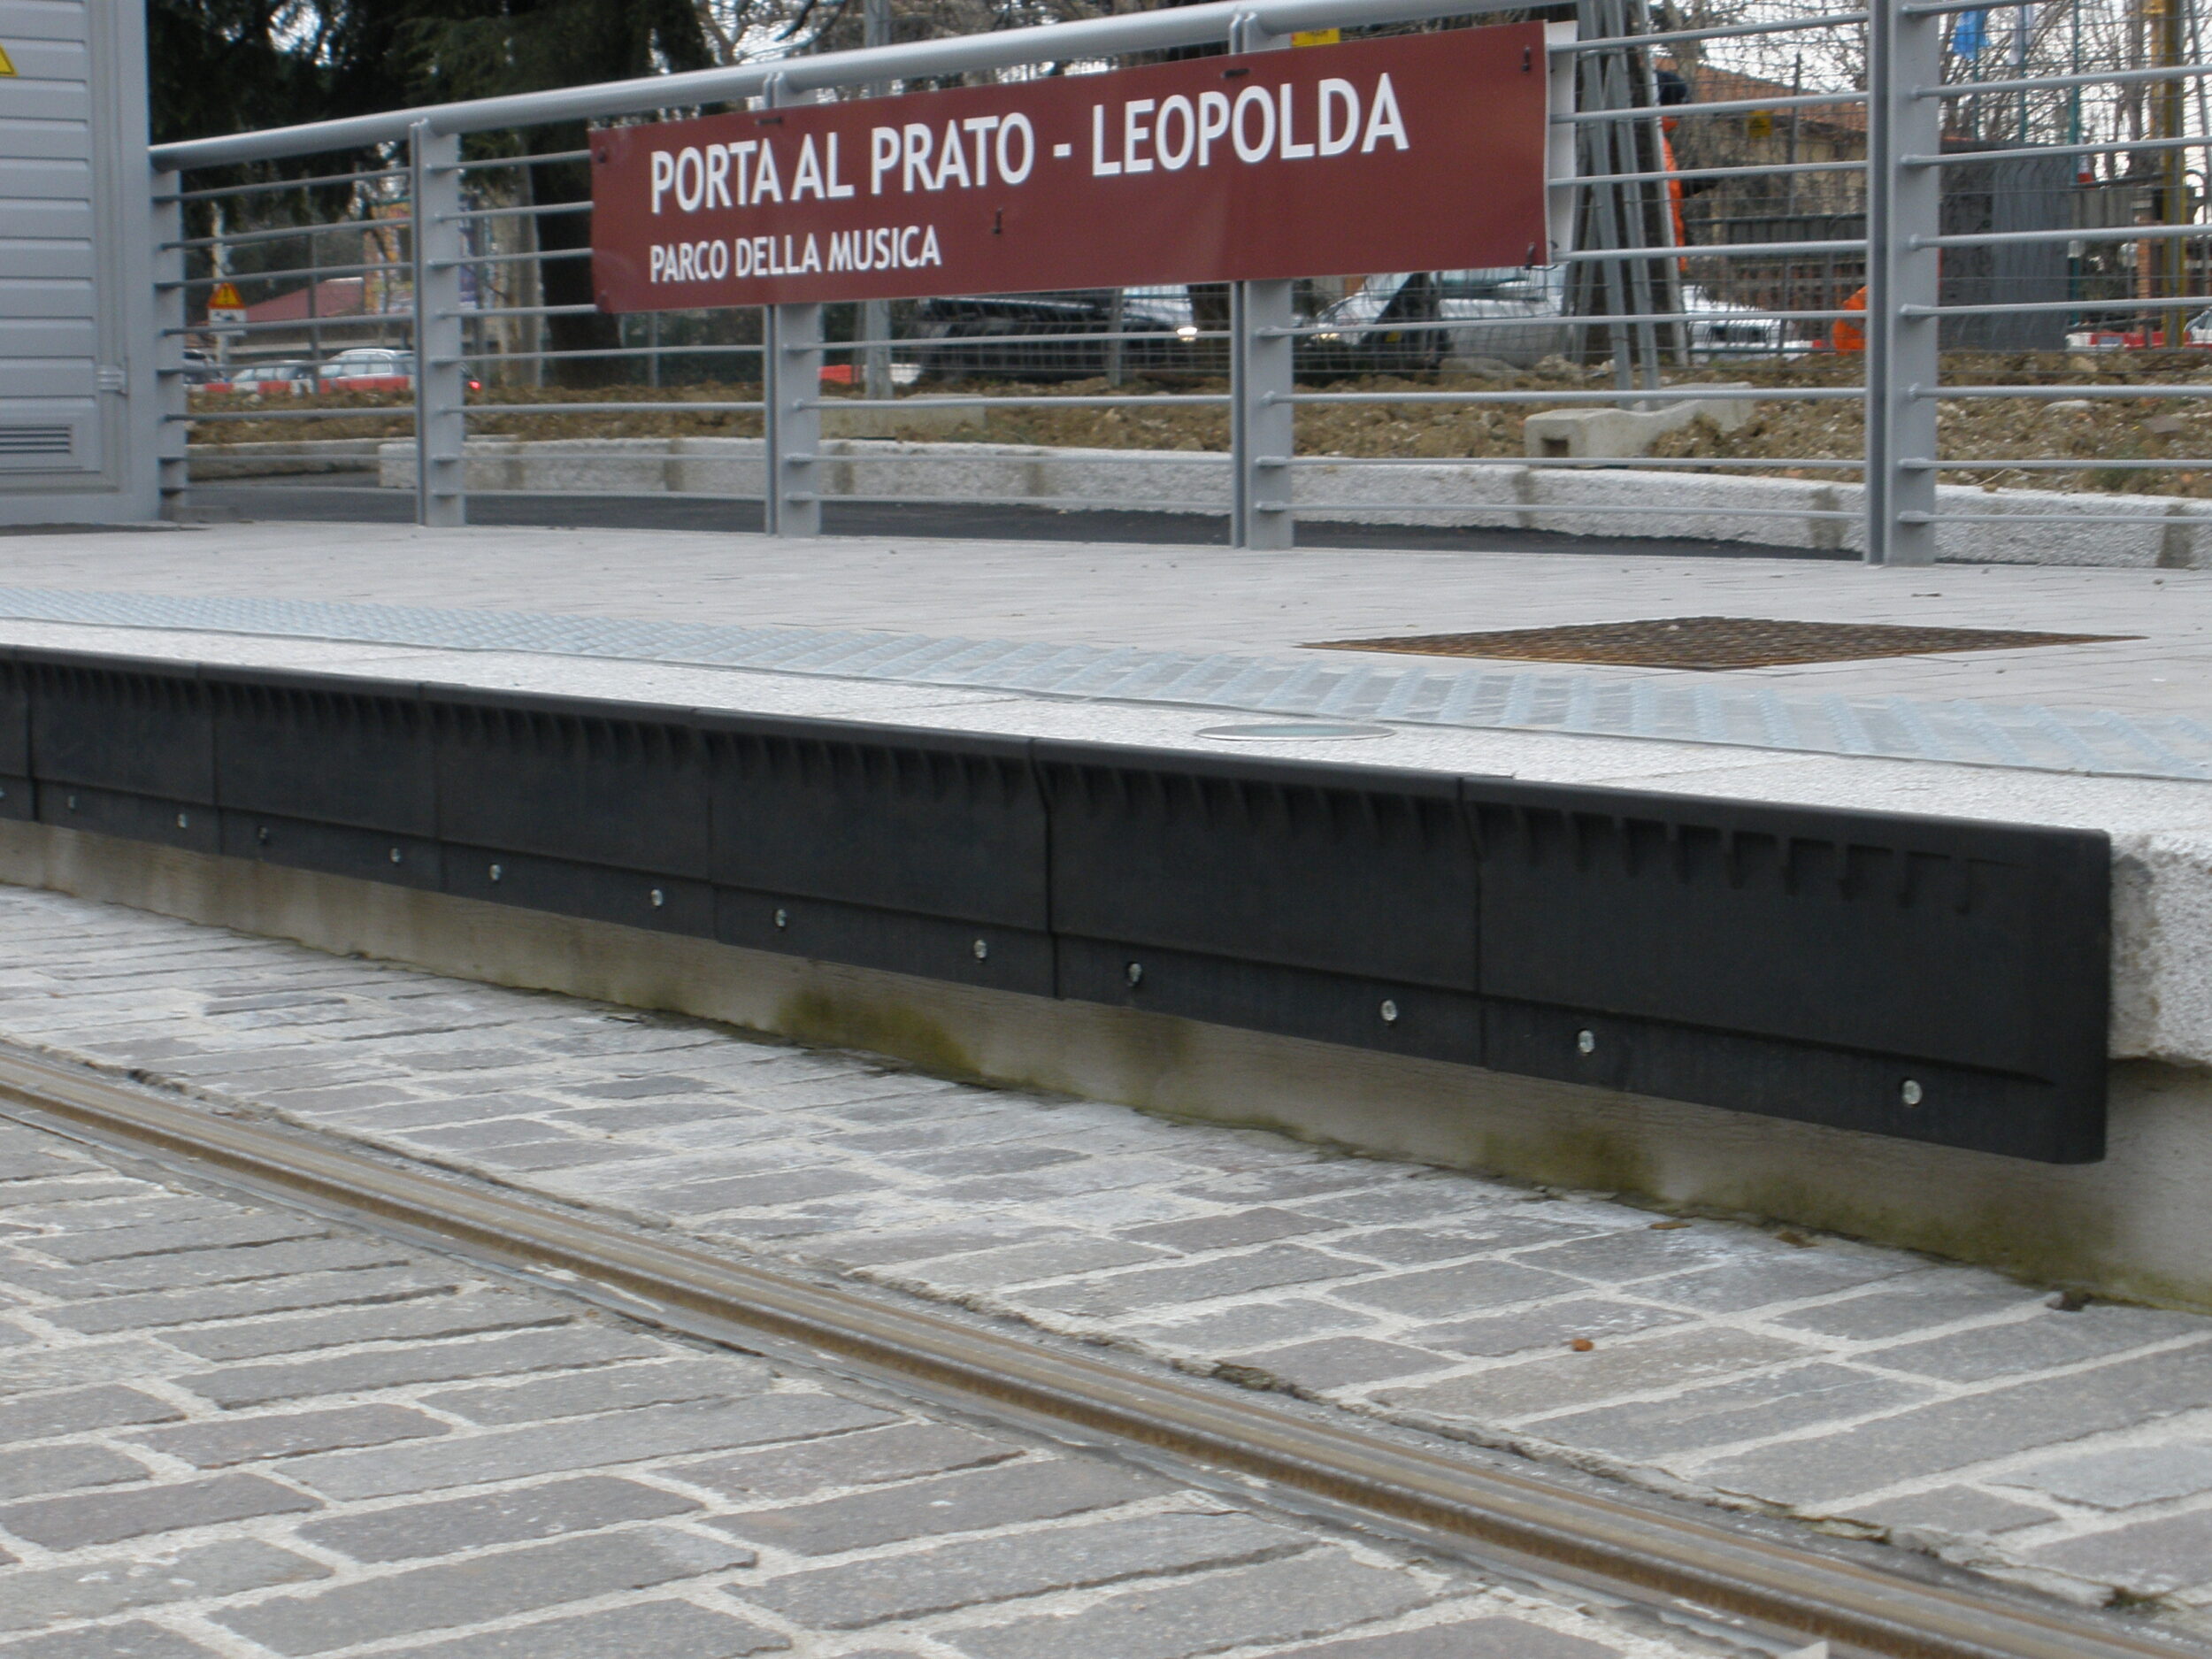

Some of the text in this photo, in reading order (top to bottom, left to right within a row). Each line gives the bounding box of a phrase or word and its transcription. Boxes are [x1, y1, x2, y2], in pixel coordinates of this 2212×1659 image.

[651, 72, 1409, 215] PORTA AL PRATO - LEOPOLDA
[650, 225, 942, 283] PARCO DELLA MUSICA
